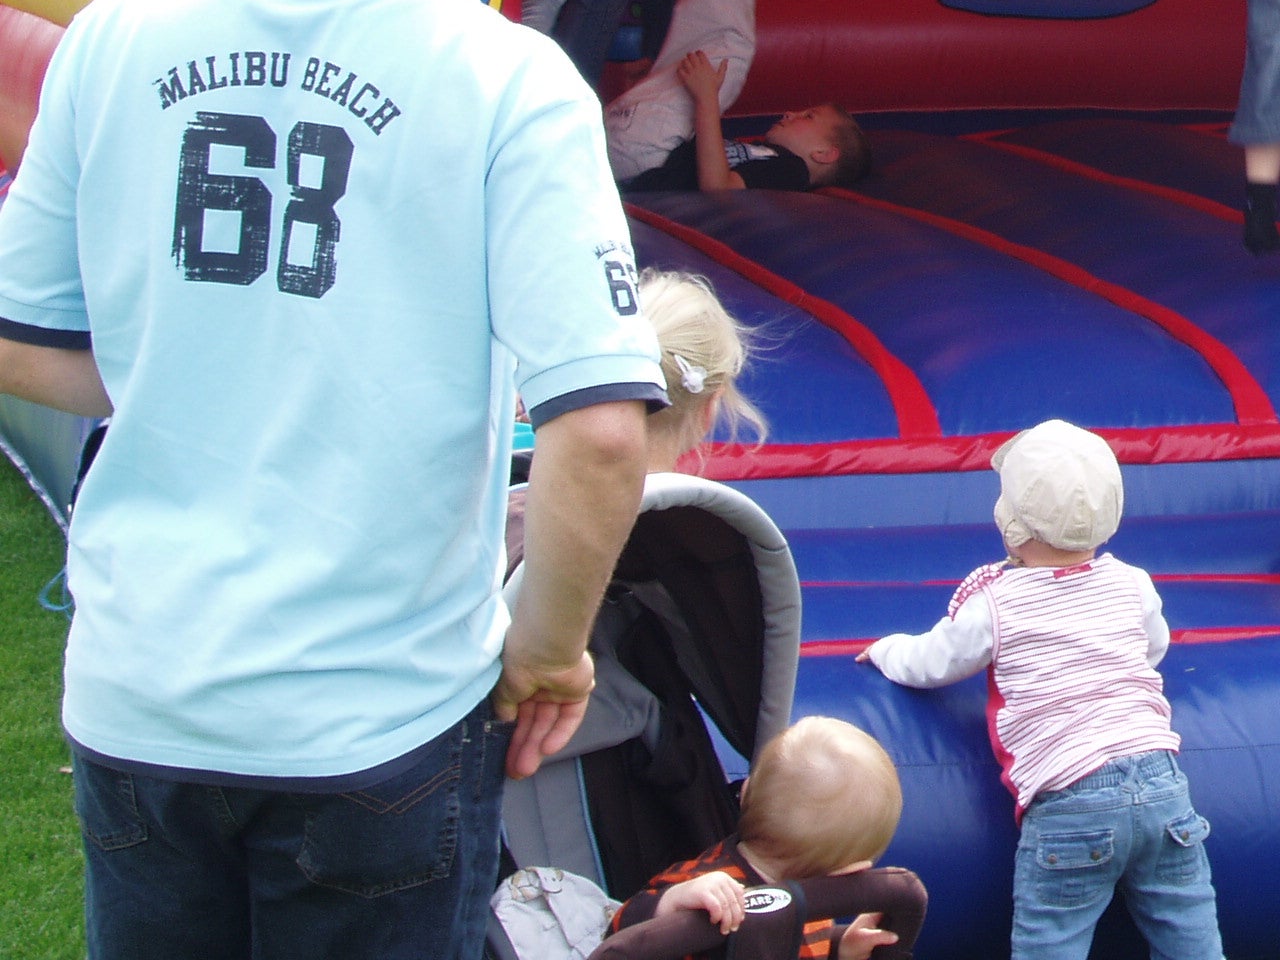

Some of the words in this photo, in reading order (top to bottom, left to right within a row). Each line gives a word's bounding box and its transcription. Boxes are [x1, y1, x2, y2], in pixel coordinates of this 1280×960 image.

[152, 51, 291, 110] MALIBU
[301, 57, 402, 136] BEACH
[171, 111, 355, 299] 68
